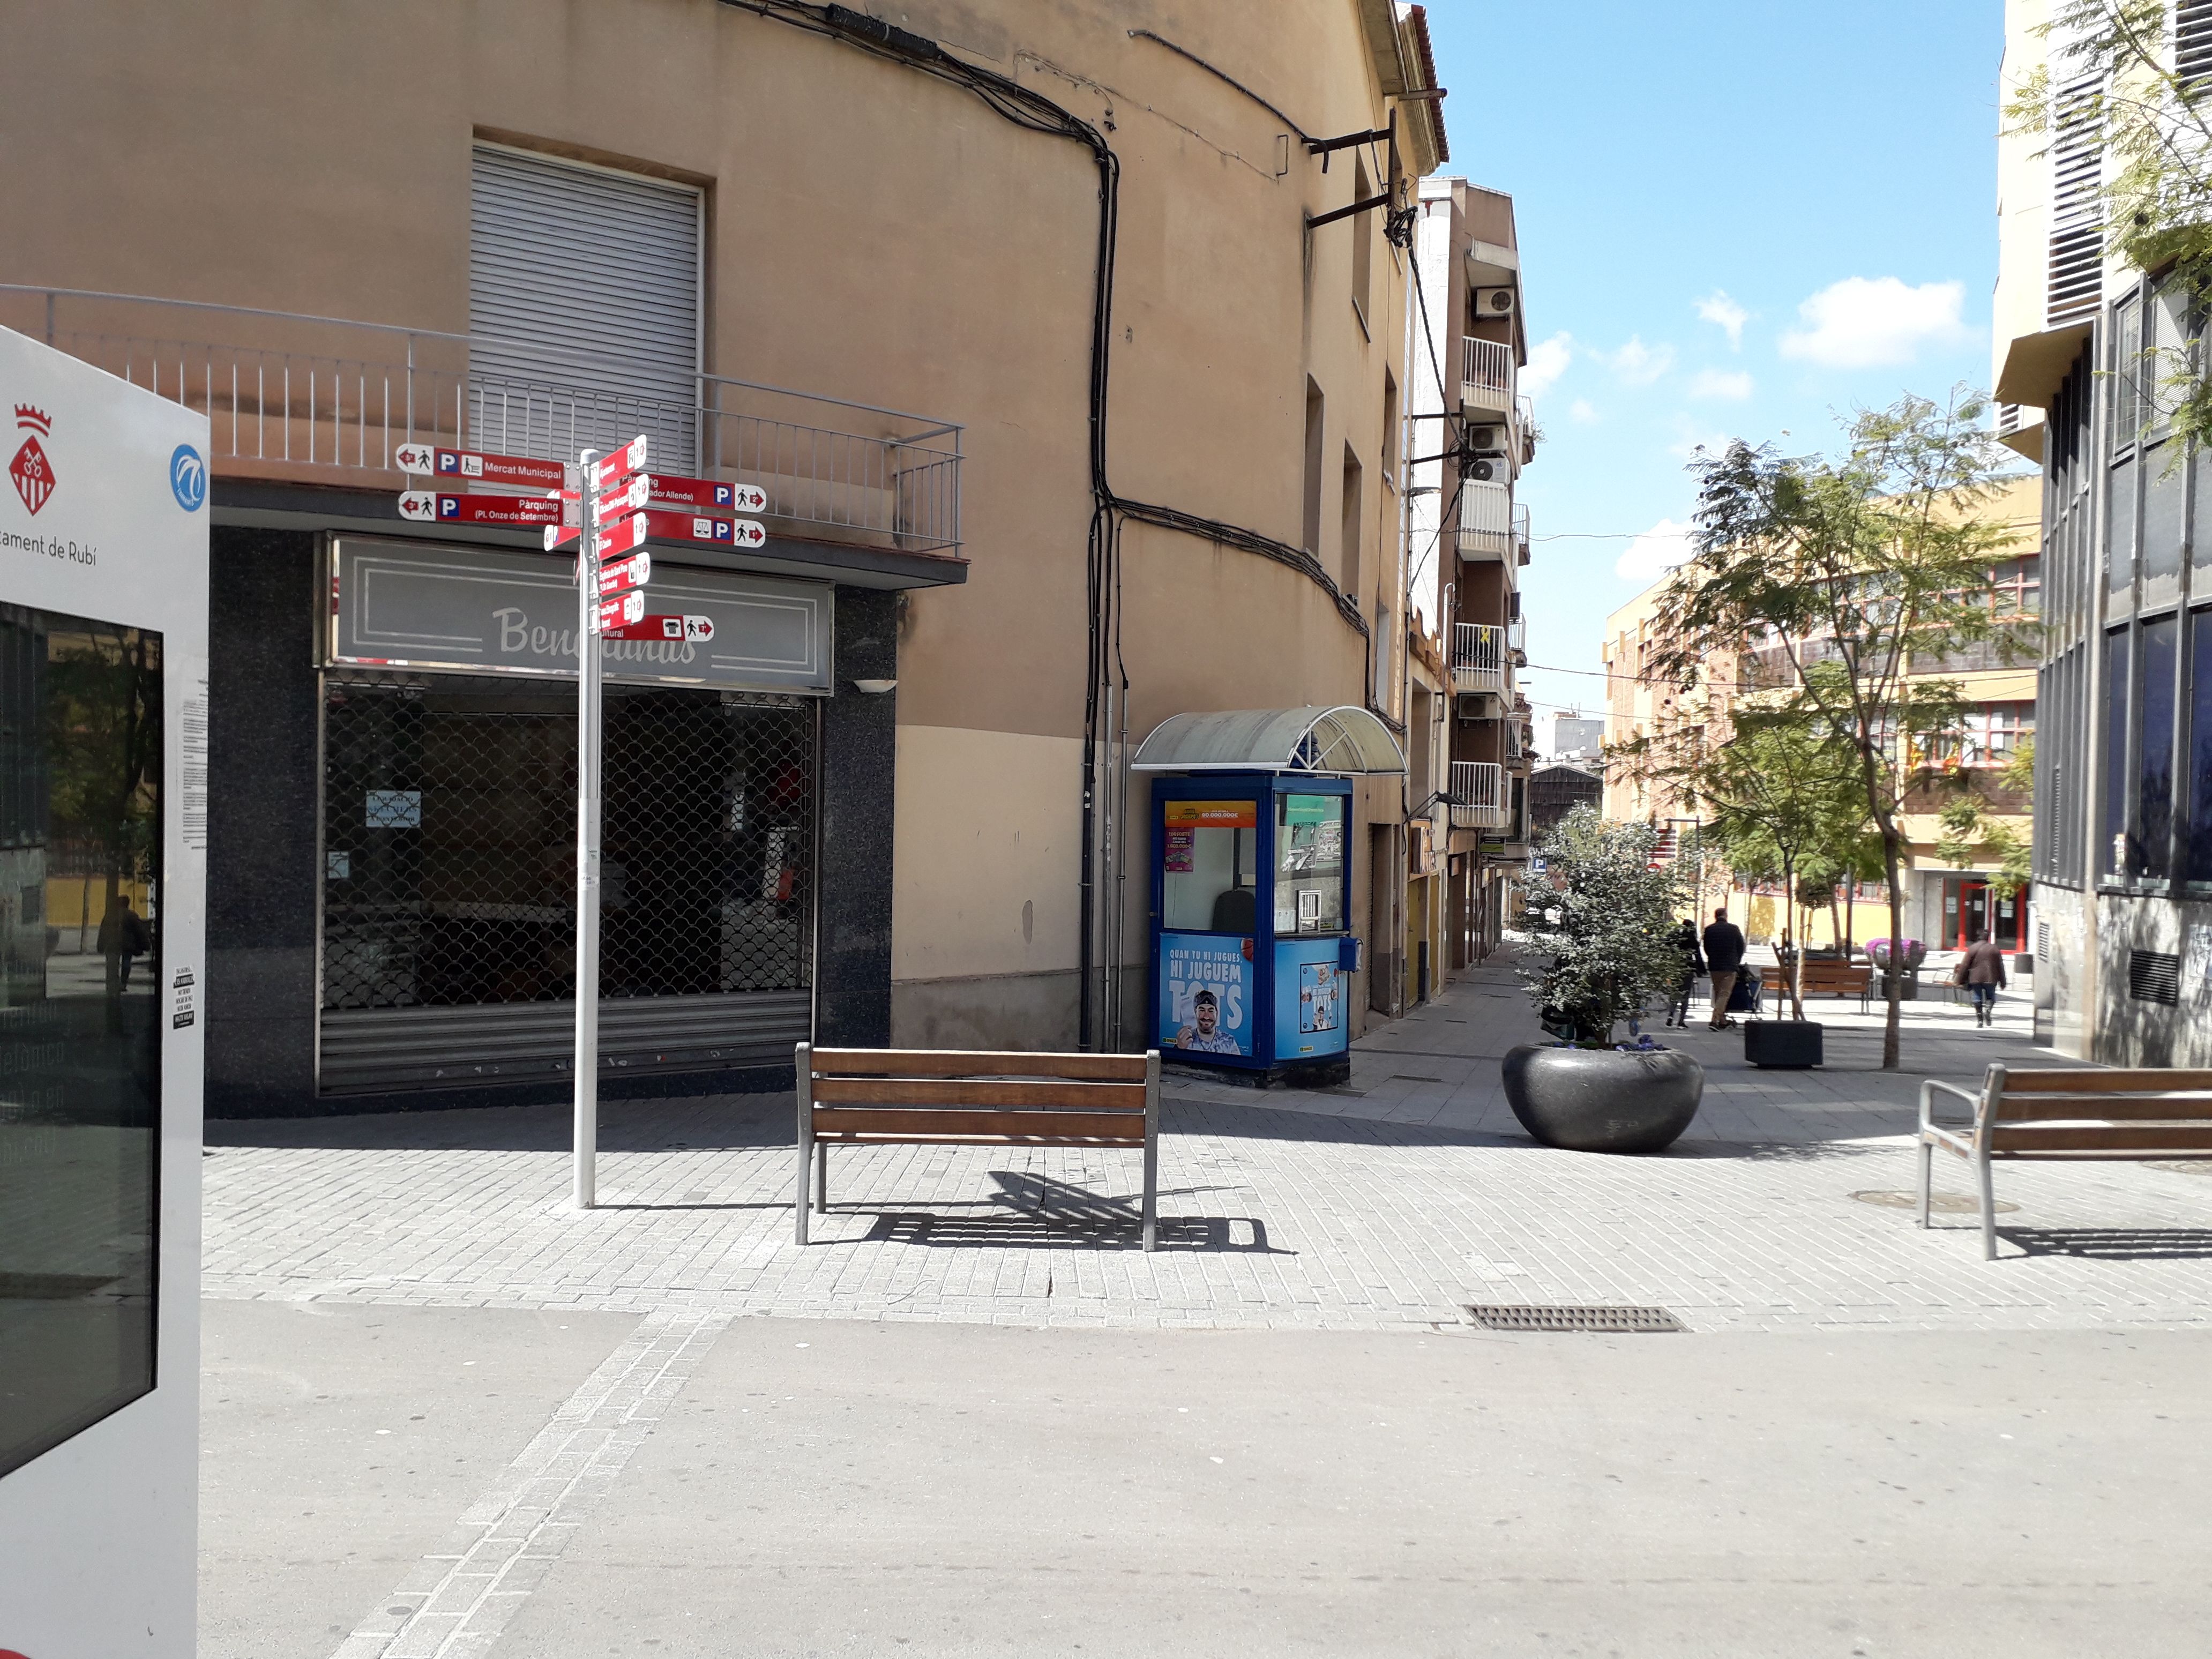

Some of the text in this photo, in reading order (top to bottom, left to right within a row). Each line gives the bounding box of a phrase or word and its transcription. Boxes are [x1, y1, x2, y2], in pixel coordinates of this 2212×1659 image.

[440, 454, 455, 470] P
[484, 462, 562, 480] Mercat Municipal
[666, 490, 694, 503] Allende)
[716, 487, 729, 503] P
[442, 498, 457, 516] P
[519, 499, 559, 512] Pàrquing
[475, 510, 558, 523] (Pl. Onze de Setembre)
[716, 523, 729, 538] P
[49, 536, 65, 558] de
[69, 540, 96, 566] Rubí
[1535, 859, 1544, 868] P
[1170, 949, 1243, 963] QUAN TU HI JUGUES,
[1170, 960, 1242, 983] HI JUGUEM
